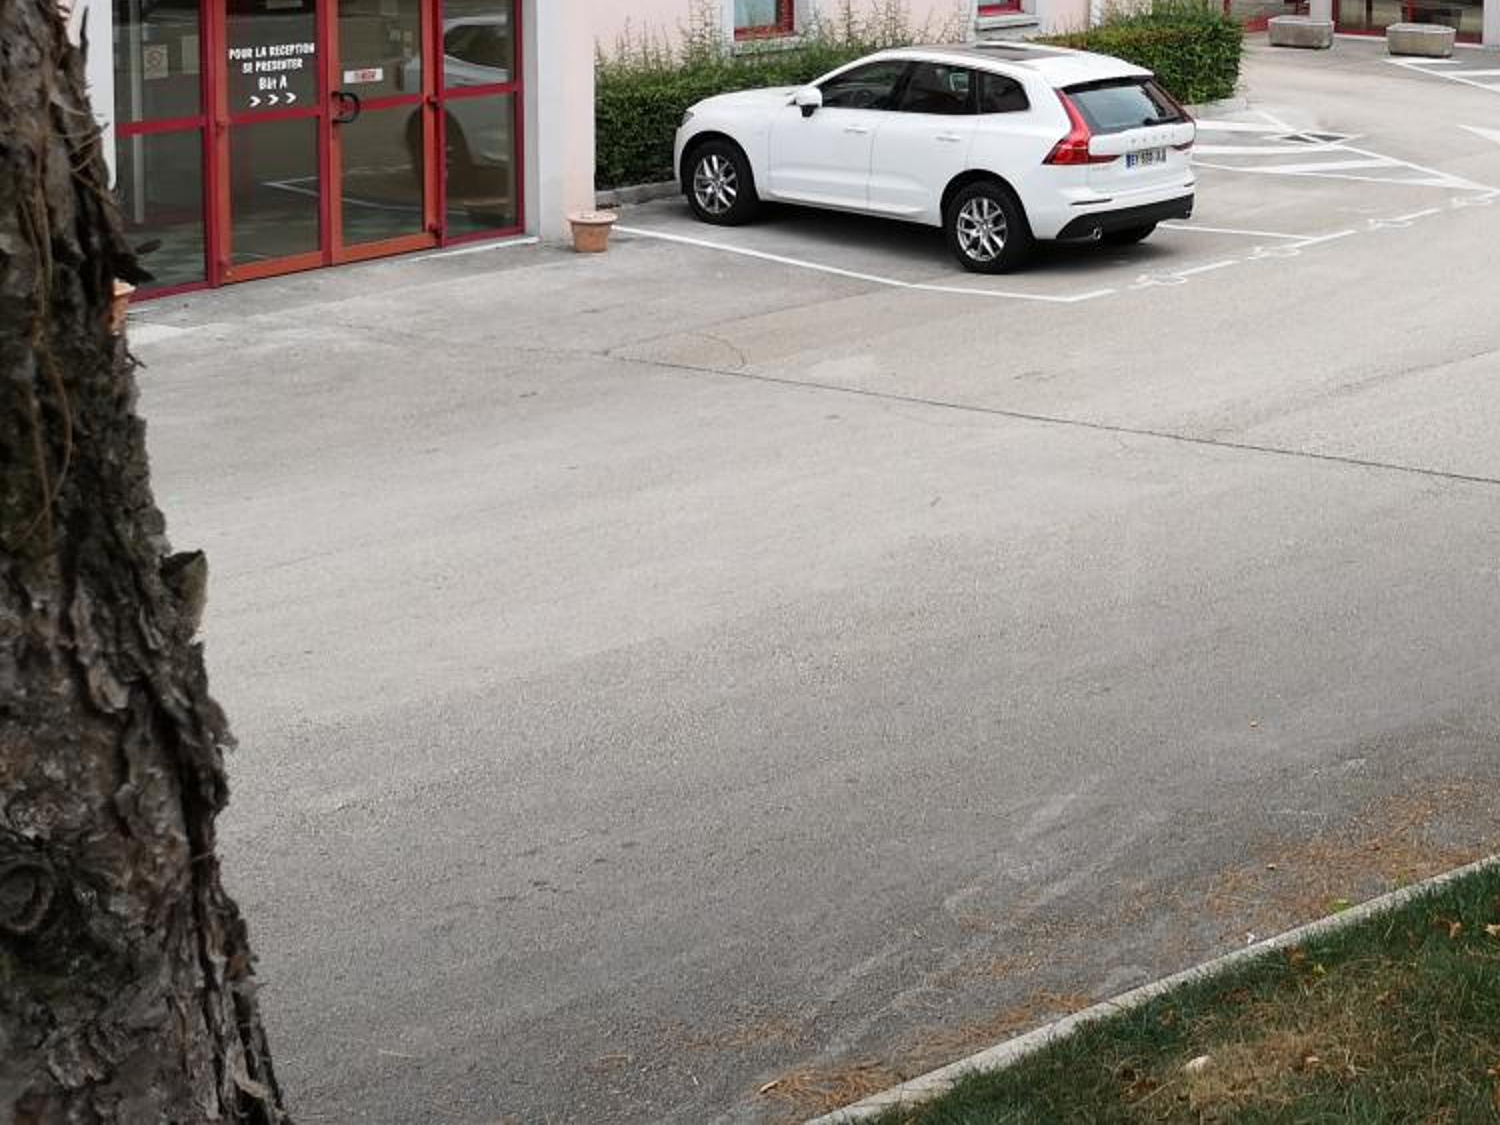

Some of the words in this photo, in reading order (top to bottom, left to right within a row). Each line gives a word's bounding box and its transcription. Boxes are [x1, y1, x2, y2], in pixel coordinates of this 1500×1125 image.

[229, 48, 253, 60] POUR
[255, 47, 267, 58] LA
[242, 62, 253, 74] SE
[279, 75, 288, 89] A
